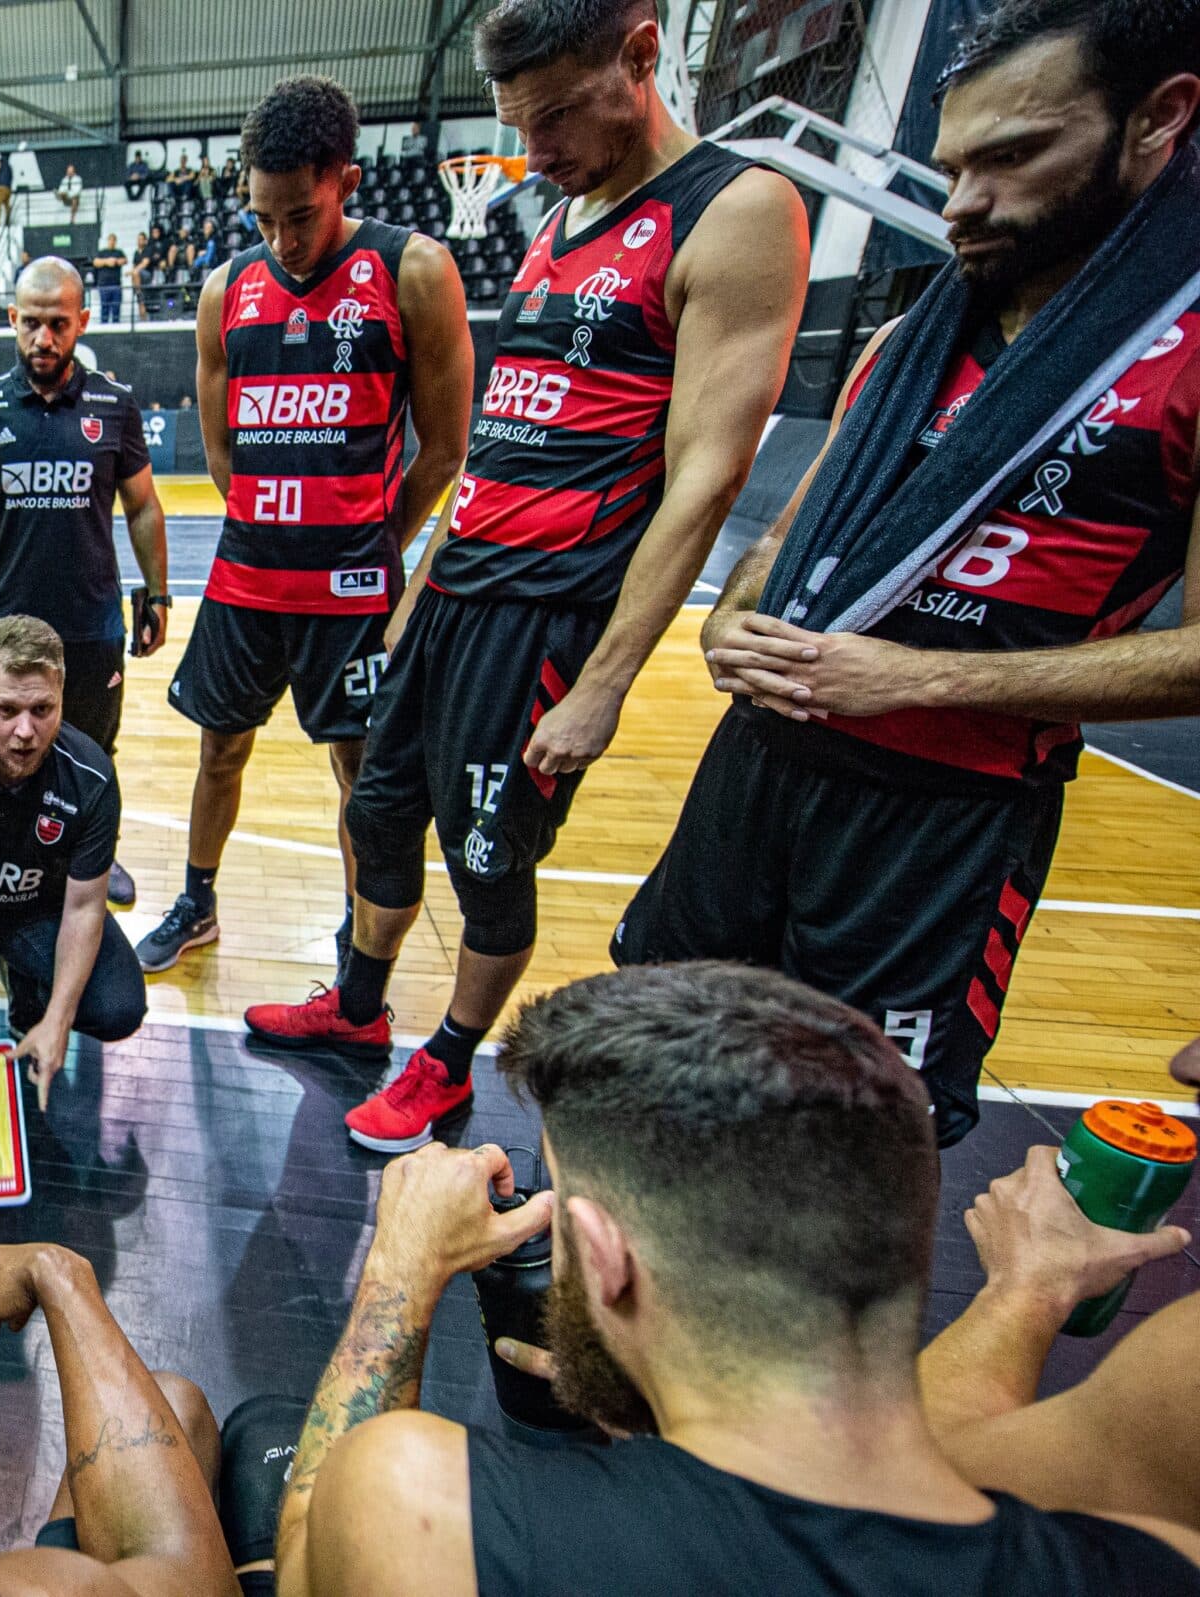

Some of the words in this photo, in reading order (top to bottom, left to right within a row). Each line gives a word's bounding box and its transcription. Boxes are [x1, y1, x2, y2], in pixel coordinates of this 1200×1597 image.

[270, 383, 351, 425] BRB
[490, 367, 572, 421] BRB
[236, 429, 273, 445] BANCO
[274, 430, 293, 444] DE
[295, 426, 346, 445] BRASÍLIA
[33, 460, 94, 494] BRB
[5, 498, 36, 510] BANCO
[38, 497, 50, 508] DE
[254, 479, 302, 522] 20
[900, 591, 988, 626] ASÍLIA
[465, 763, 510, 814] 12
